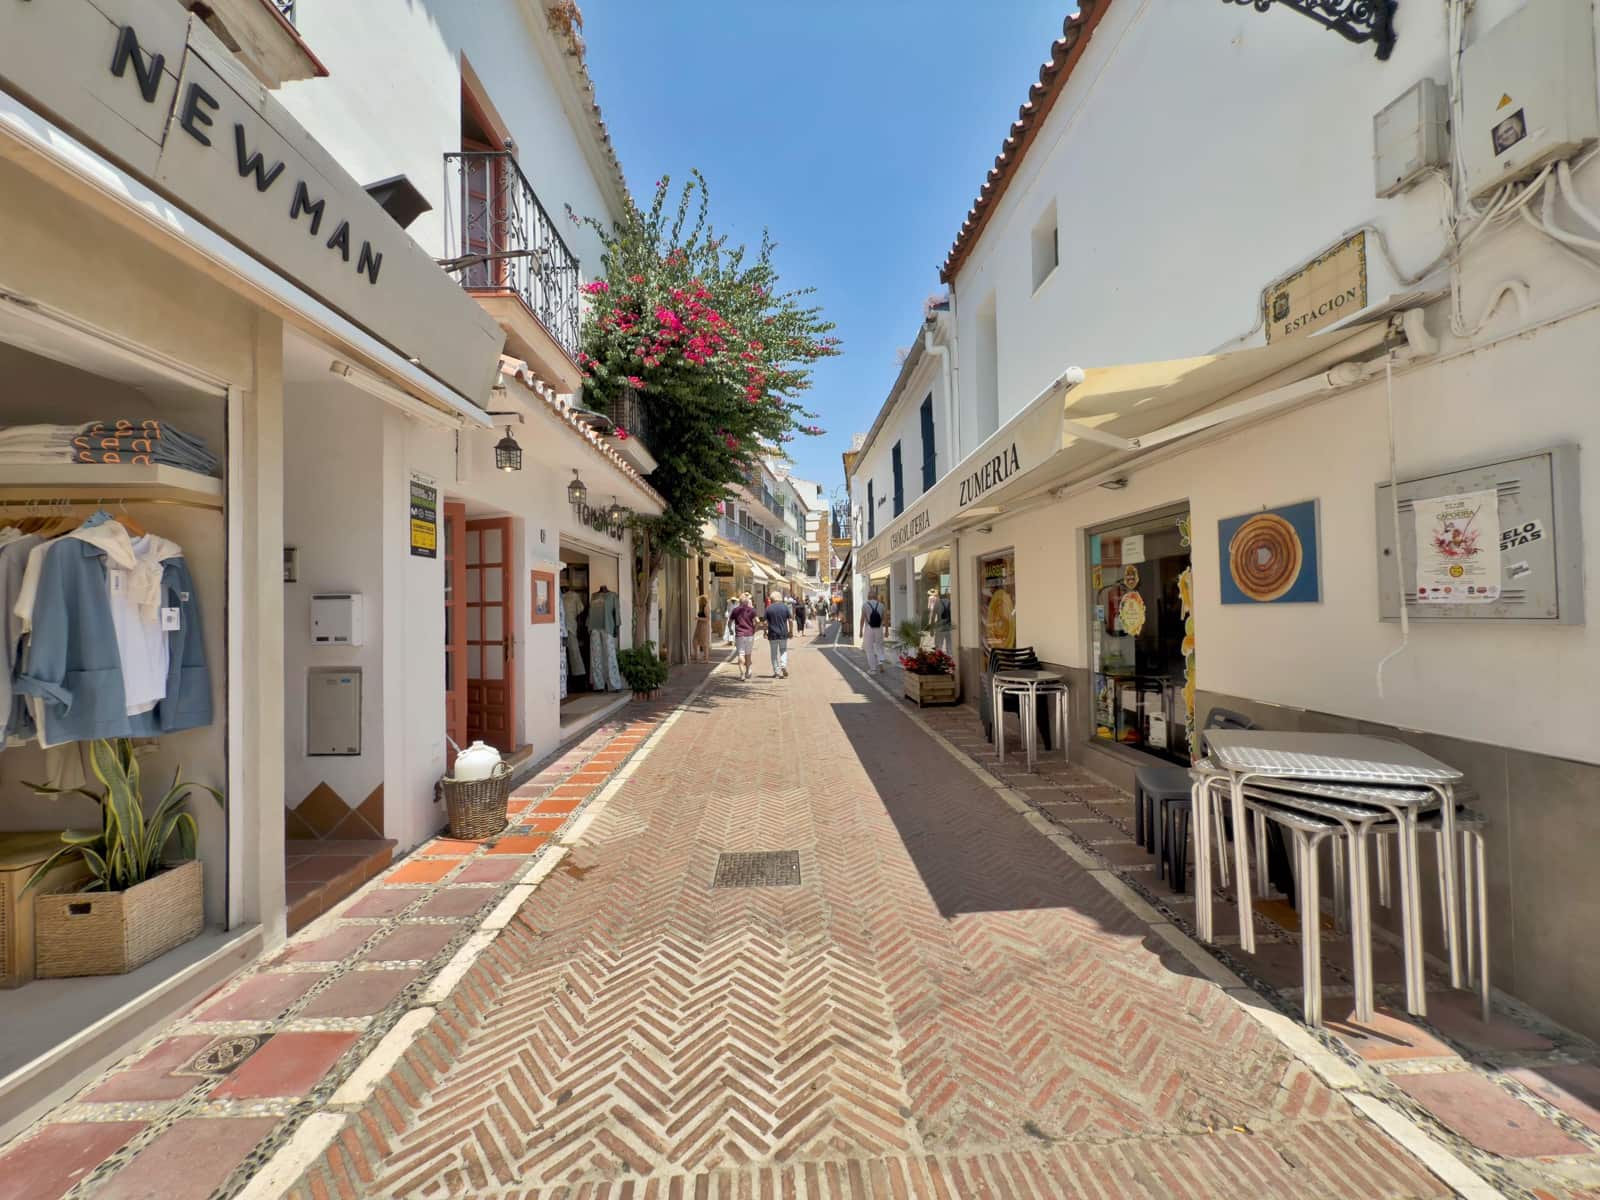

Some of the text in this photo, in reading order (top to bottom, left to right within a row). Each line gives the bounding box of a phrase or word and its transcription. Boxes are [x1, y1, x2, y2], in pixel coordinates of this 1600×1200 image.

[110, 25, 384, 286] NEWMAN
[1285, 287, 1355, 334] ESTACION
[959, 443, 1020, 506] ZUMERIA
[1500, 522, 1536, 542] ELO
